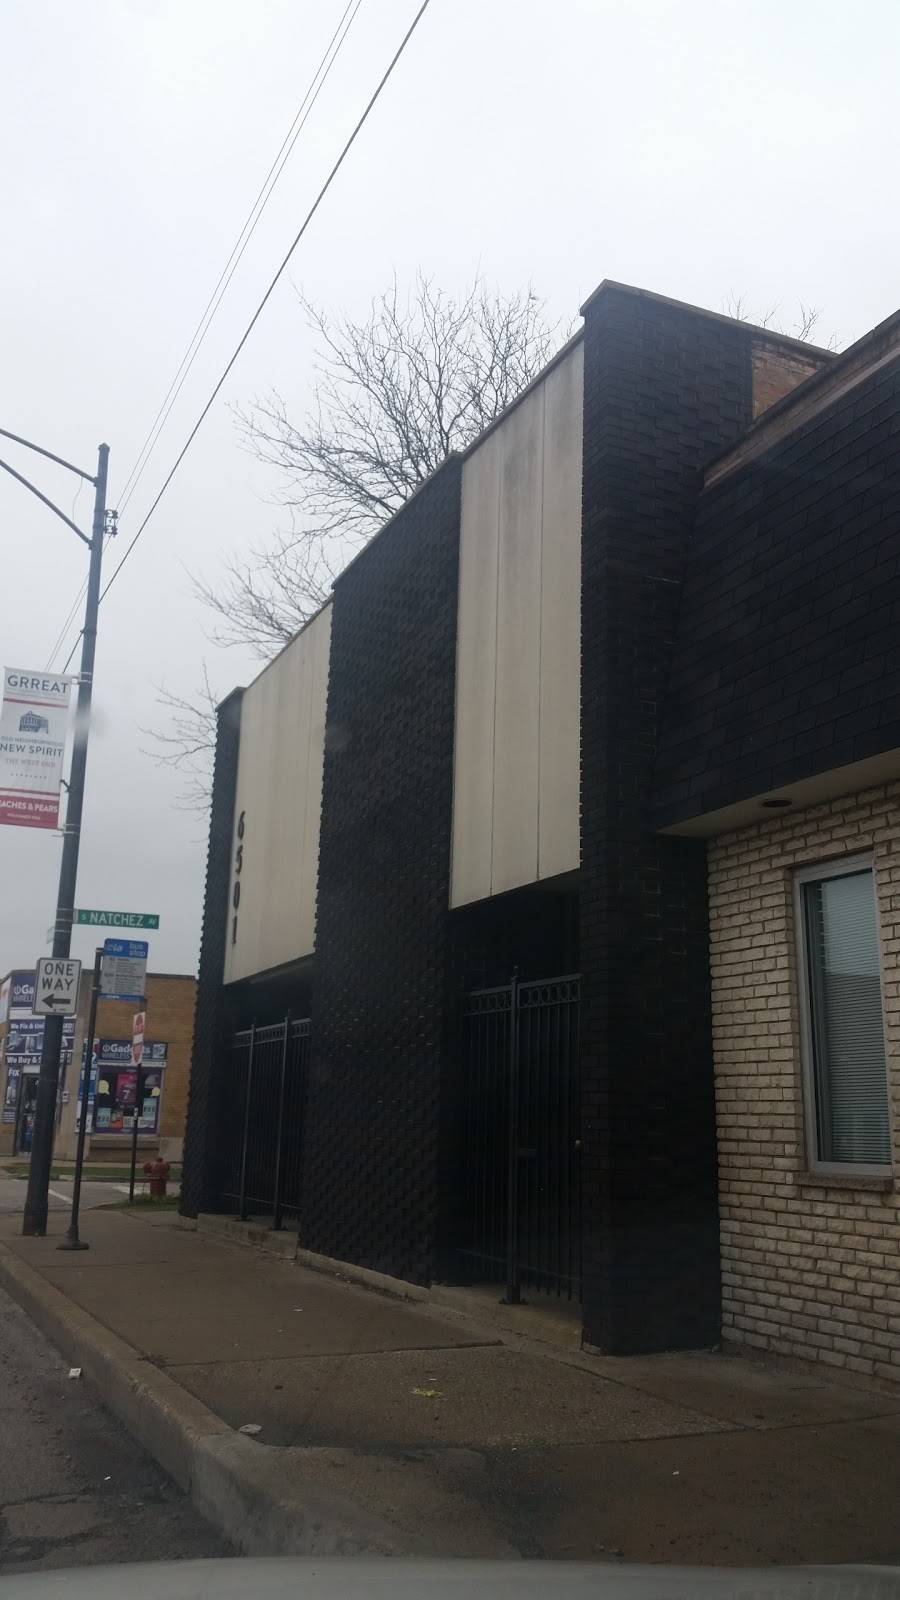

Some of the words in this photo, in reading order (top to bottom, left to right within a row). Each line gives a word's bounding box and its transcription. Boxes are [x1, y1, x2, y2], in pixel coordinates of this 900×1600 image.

[7, 674, 69, 694] GRREAT
[0, 743, 26, 753] NEW
[28, 745, 64, 757] SPIRIT
[34, 803, 58, 813] PEARS
[89, 911, 144, 927] NATCHEZ
[44, 962, 74, 976] ONE
[42, 977, 74, 991] WAY
[18, 1056, 31, 1065] Buy
